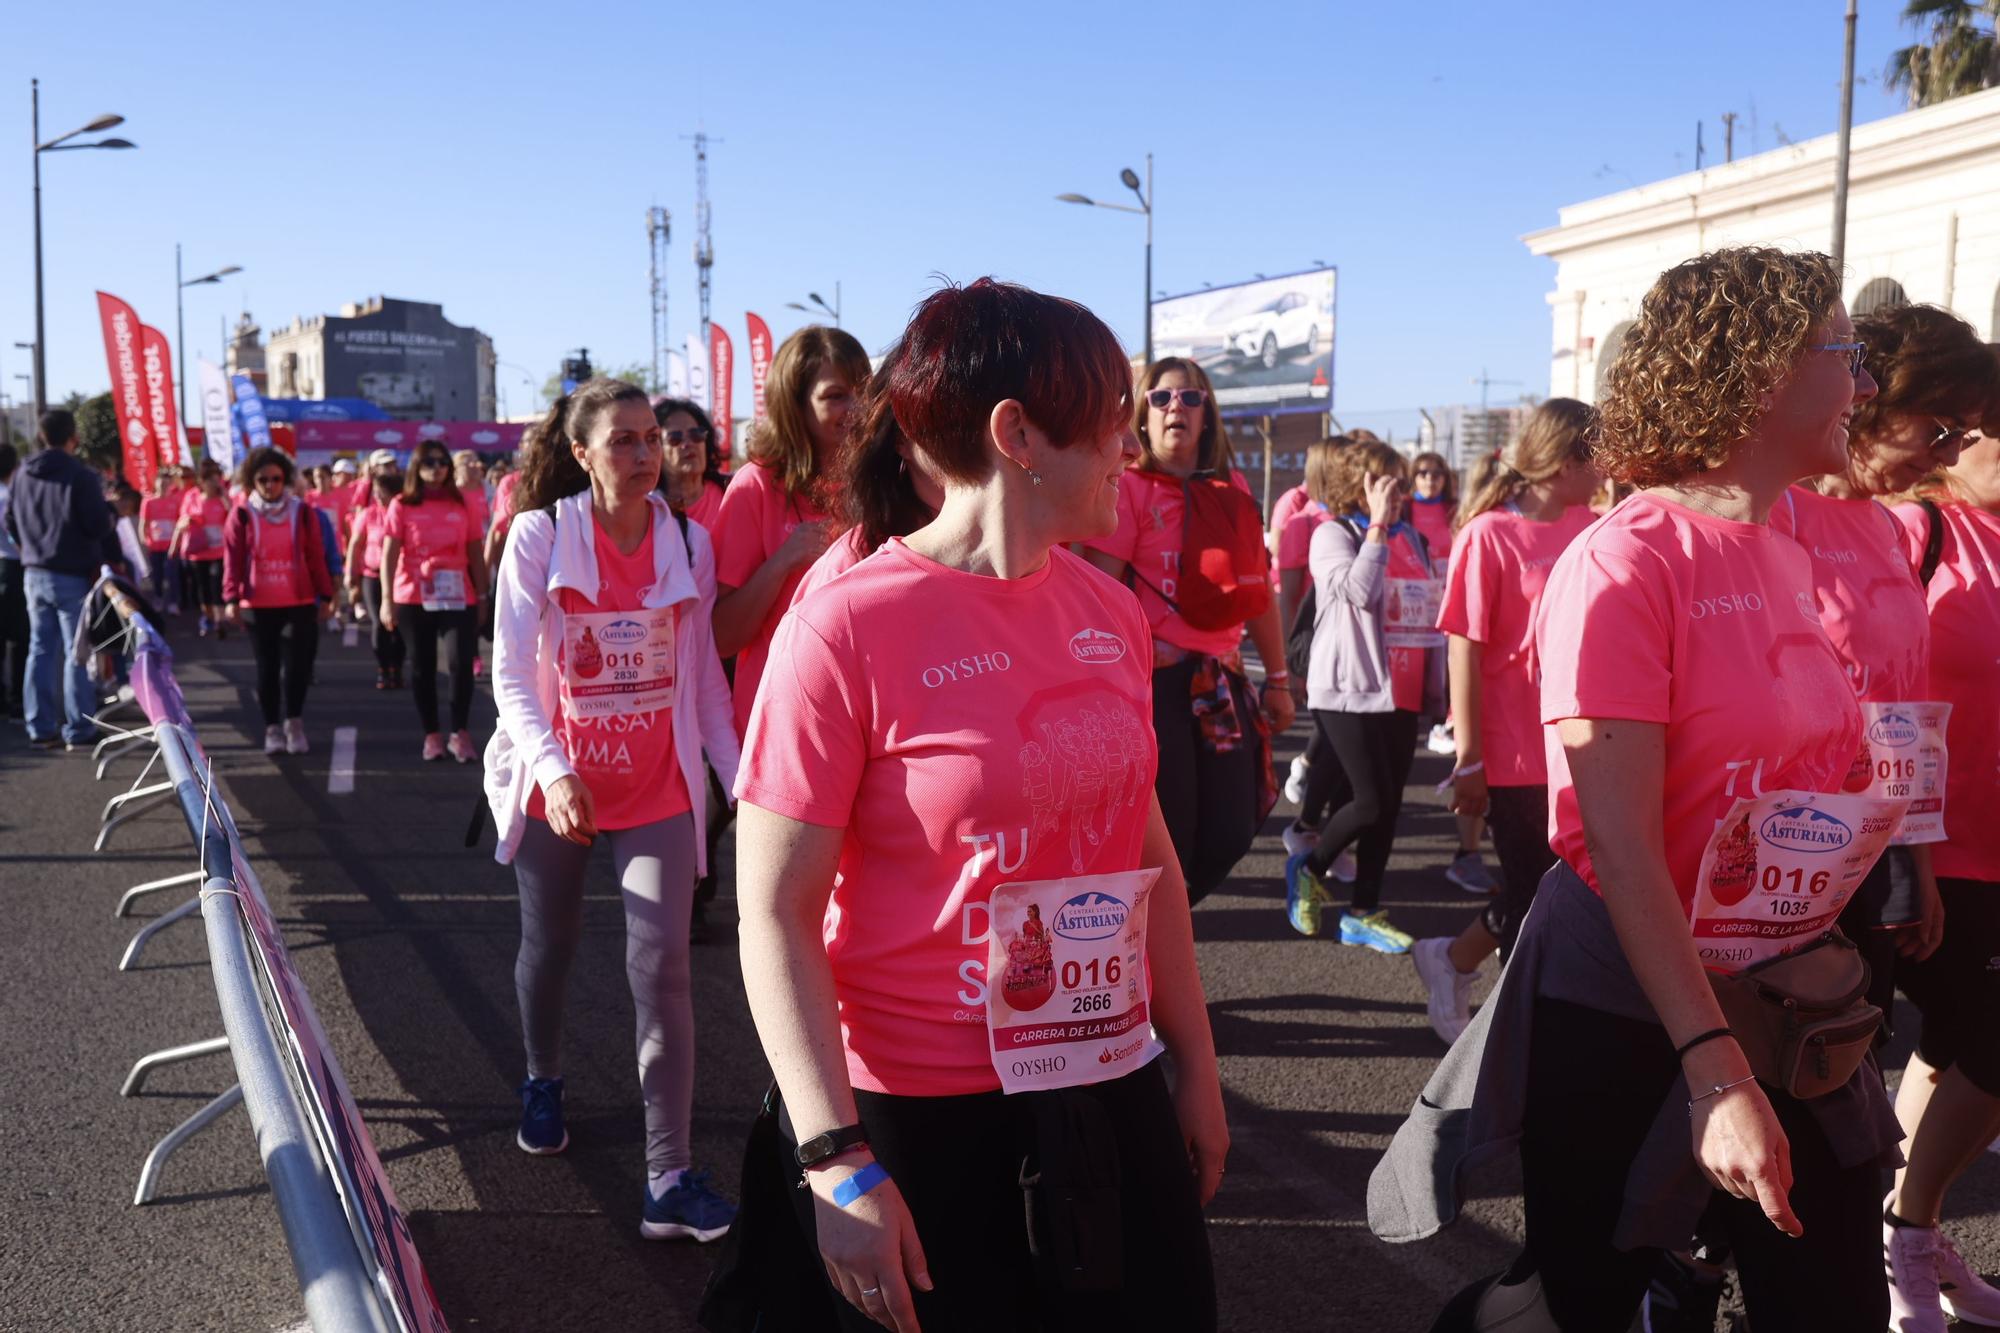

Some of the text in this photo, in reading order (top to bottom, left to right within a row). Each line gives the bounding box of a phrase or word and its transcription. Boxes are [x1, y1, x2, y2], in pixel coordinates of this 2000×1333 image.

[603, 630, 645, 640] ASTURIANA
[606, 652, 644, 667] 016
[1076, 644, 1121, 657] ASTURIANA
[614, 670, 639, 680] 2830
[922, 651, 1011, 688] OYSHO
[580, 700, 615, 709] OYSHO
[1874, 727, 1915, 740] ASTURIANA
[1877, 759, 1915, 779] 016
[1886, 783, 1910, 796] 1029
[1766, 821, 1843, 845] ASTURIANA
[1860, 823, 1890, 834] SUMA
[961, 828, 1029, 878] TU
[1761, 865, 1831, 895] 016
[1770, 899, 1810, 916] 1035
[1057, 911, 1125, 930] ASTURIANA
[1713, 923, 1759, 934] CARRERA
[1760, 925, 1779, 935] DE
[1780, 925, 1792, 935] LA
[1700, 947, 1753, 961] OYSHO
[1061, 955, 1121, 989] 016
[1072, 993, 1112, 1013] 2666
[1013, 1027, 1065, 1043] CARRERA
[1069, 1026, 1085, 1037] DE
[1087, 1024, 1100, 1035] LA
[1103, 1017, 1129, 1032] MUJER
[1113, 1038, 1144, 1062] Santander
[1012, 1055, 1066, 1078] OYSHO
